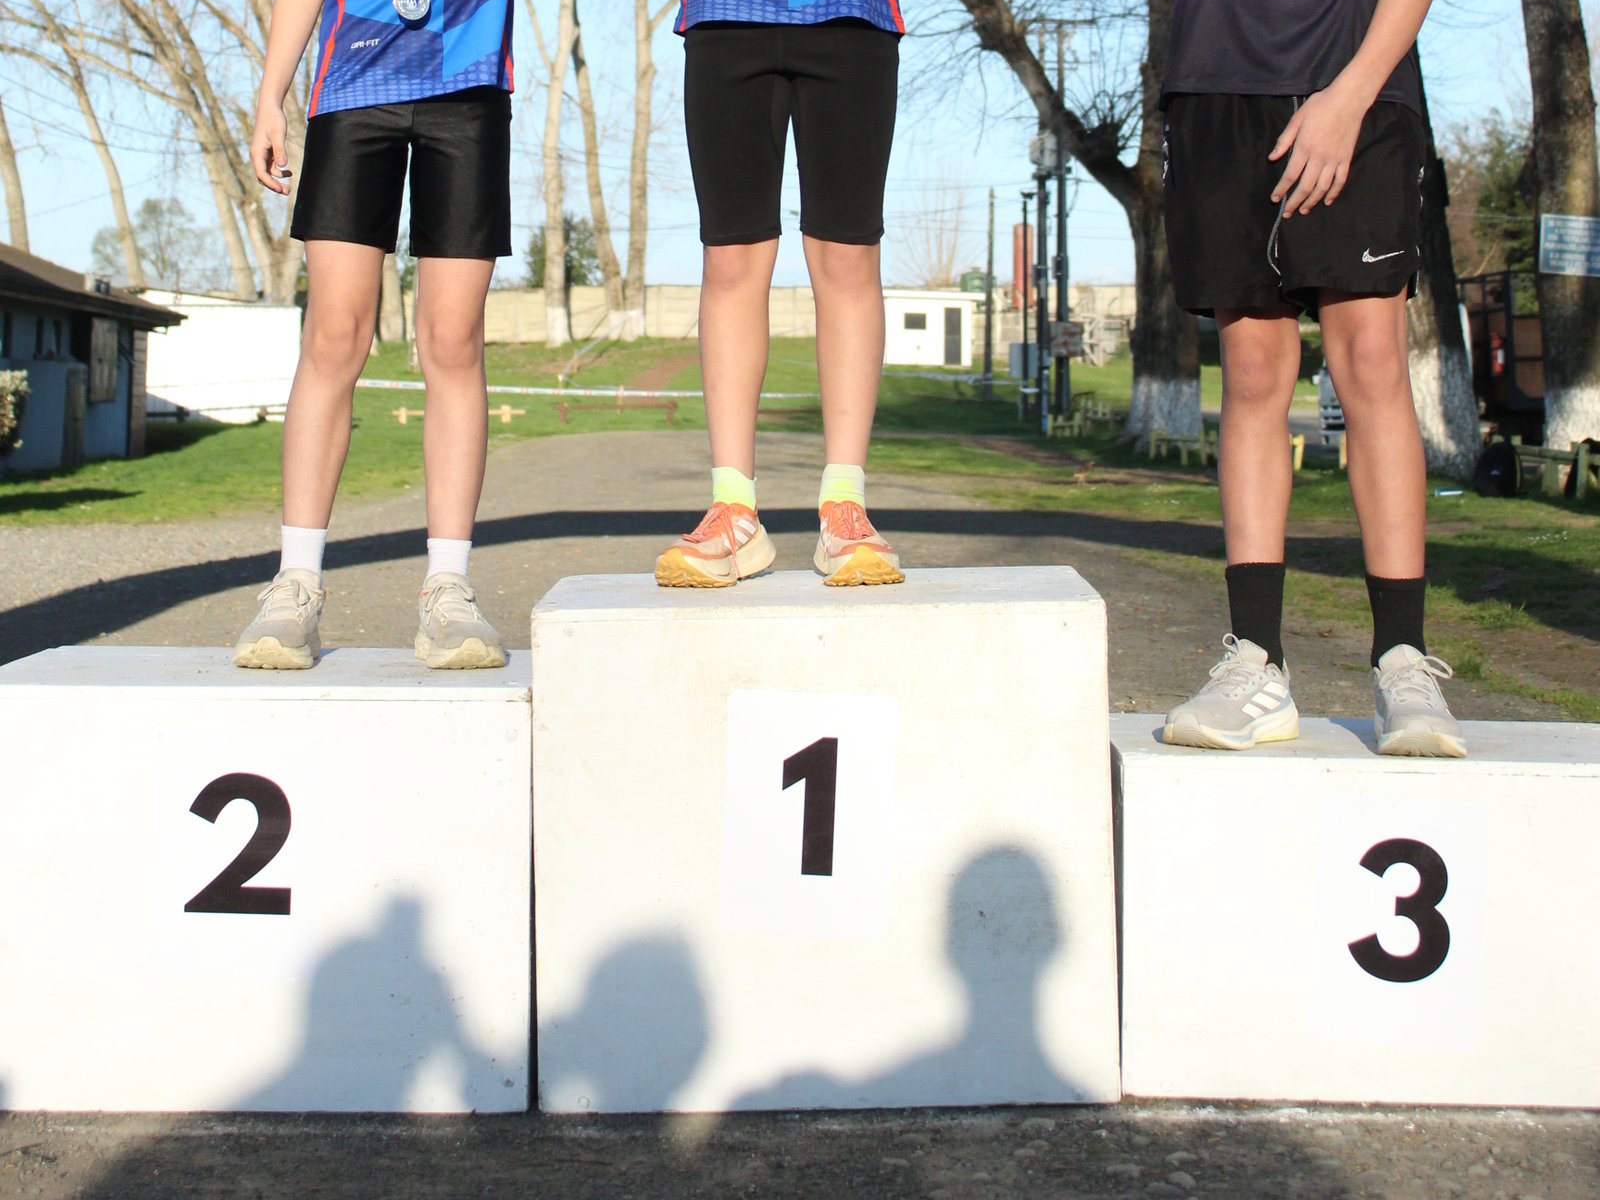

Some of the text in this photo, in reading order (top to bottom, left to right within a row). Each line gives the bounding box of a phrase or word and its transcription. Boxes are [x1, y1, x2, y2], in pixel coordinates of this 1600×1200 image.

[185, 774, 290, 915] 2
[783, 738, 837, 876] 1
[1349, 839, 1450, 982] 3
